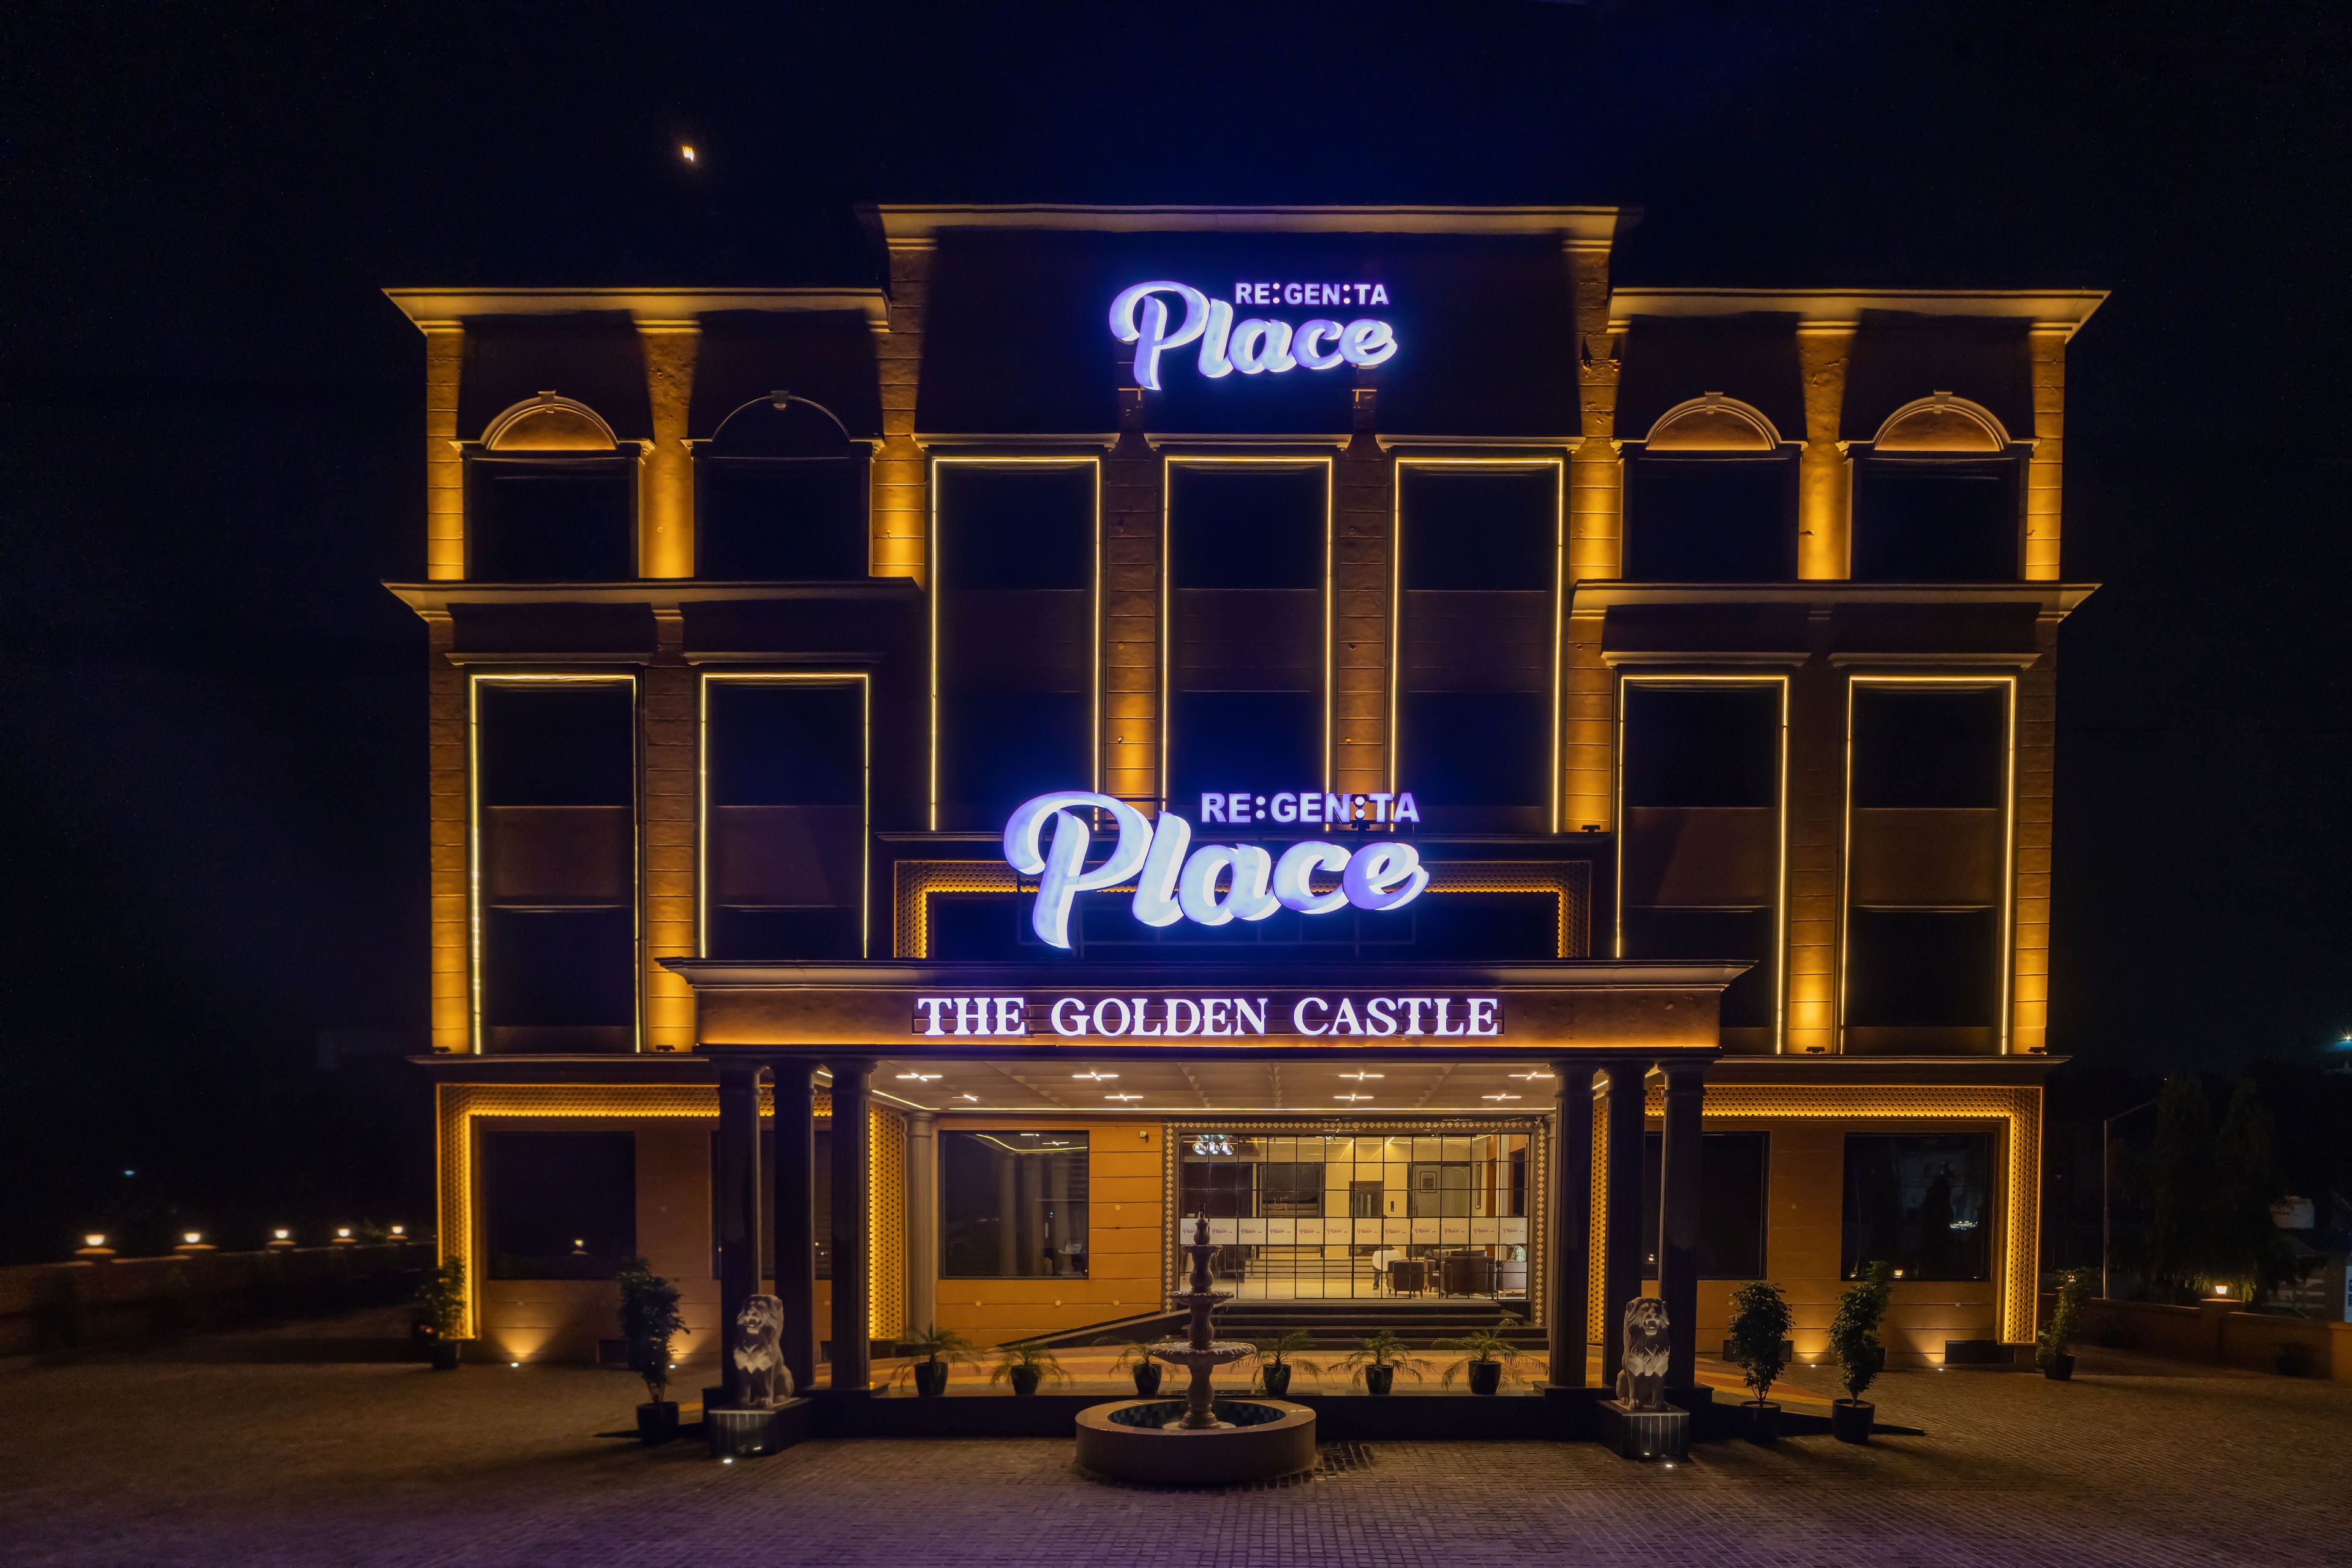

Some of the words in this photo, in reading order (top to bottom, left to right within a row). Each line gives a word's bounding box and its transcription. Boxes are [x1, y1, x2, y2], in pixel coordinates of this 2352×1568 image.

[1109, 281, 1398, 391] Place
[1004, 791, 1430, 949] Place
[918, 997, 1025, 1036] THE
[1050, 997, 1268, 1037] GOLDEN
[1294, 997, 1498, 1036] CASTLE
